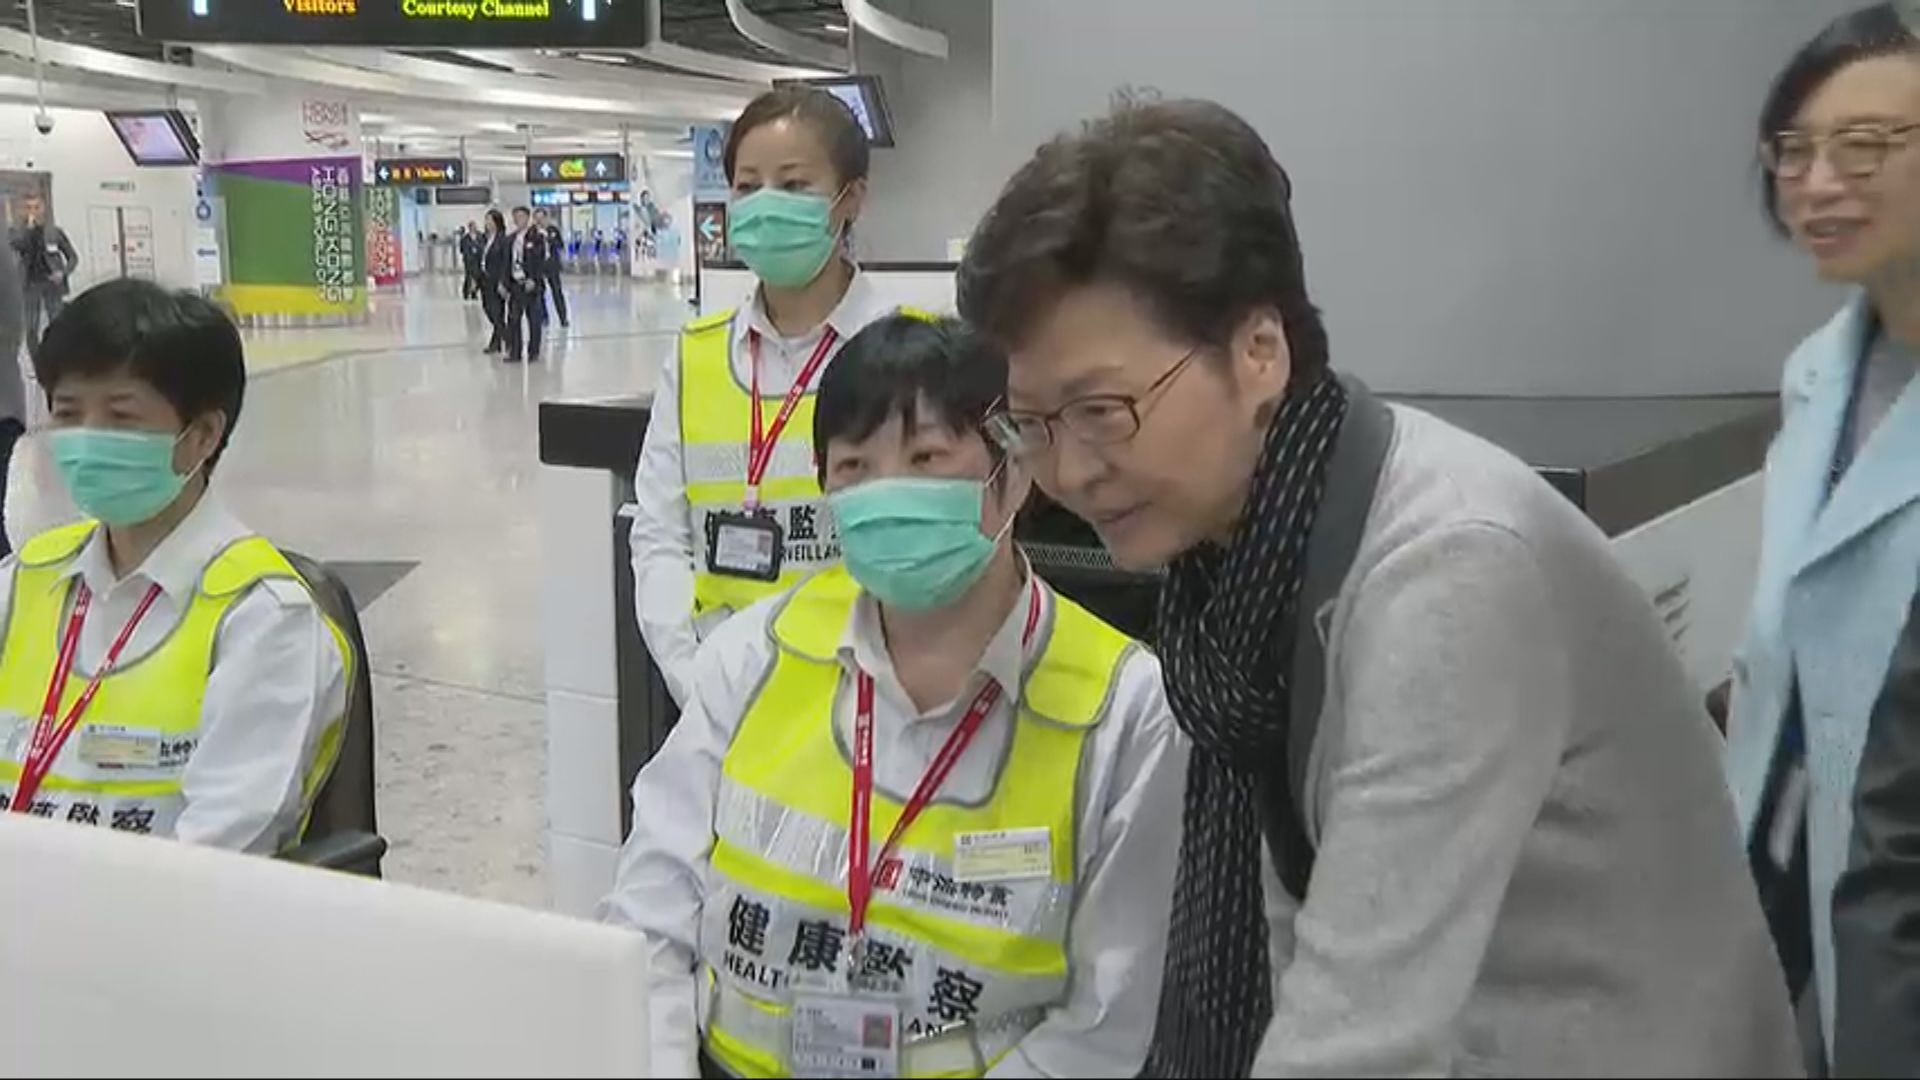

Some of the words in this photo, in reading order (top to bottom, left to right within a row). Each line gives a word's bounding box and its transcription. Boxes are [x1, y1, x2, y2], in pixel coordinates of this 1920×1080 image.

[284, 0, 356, 15] Visitors
[402, 0, 477, 20] Courtesy
[481, 0, 549, 17] Channel
[322, 166, 338, 232] HONG
[326, 237, 342, 302] KONG
